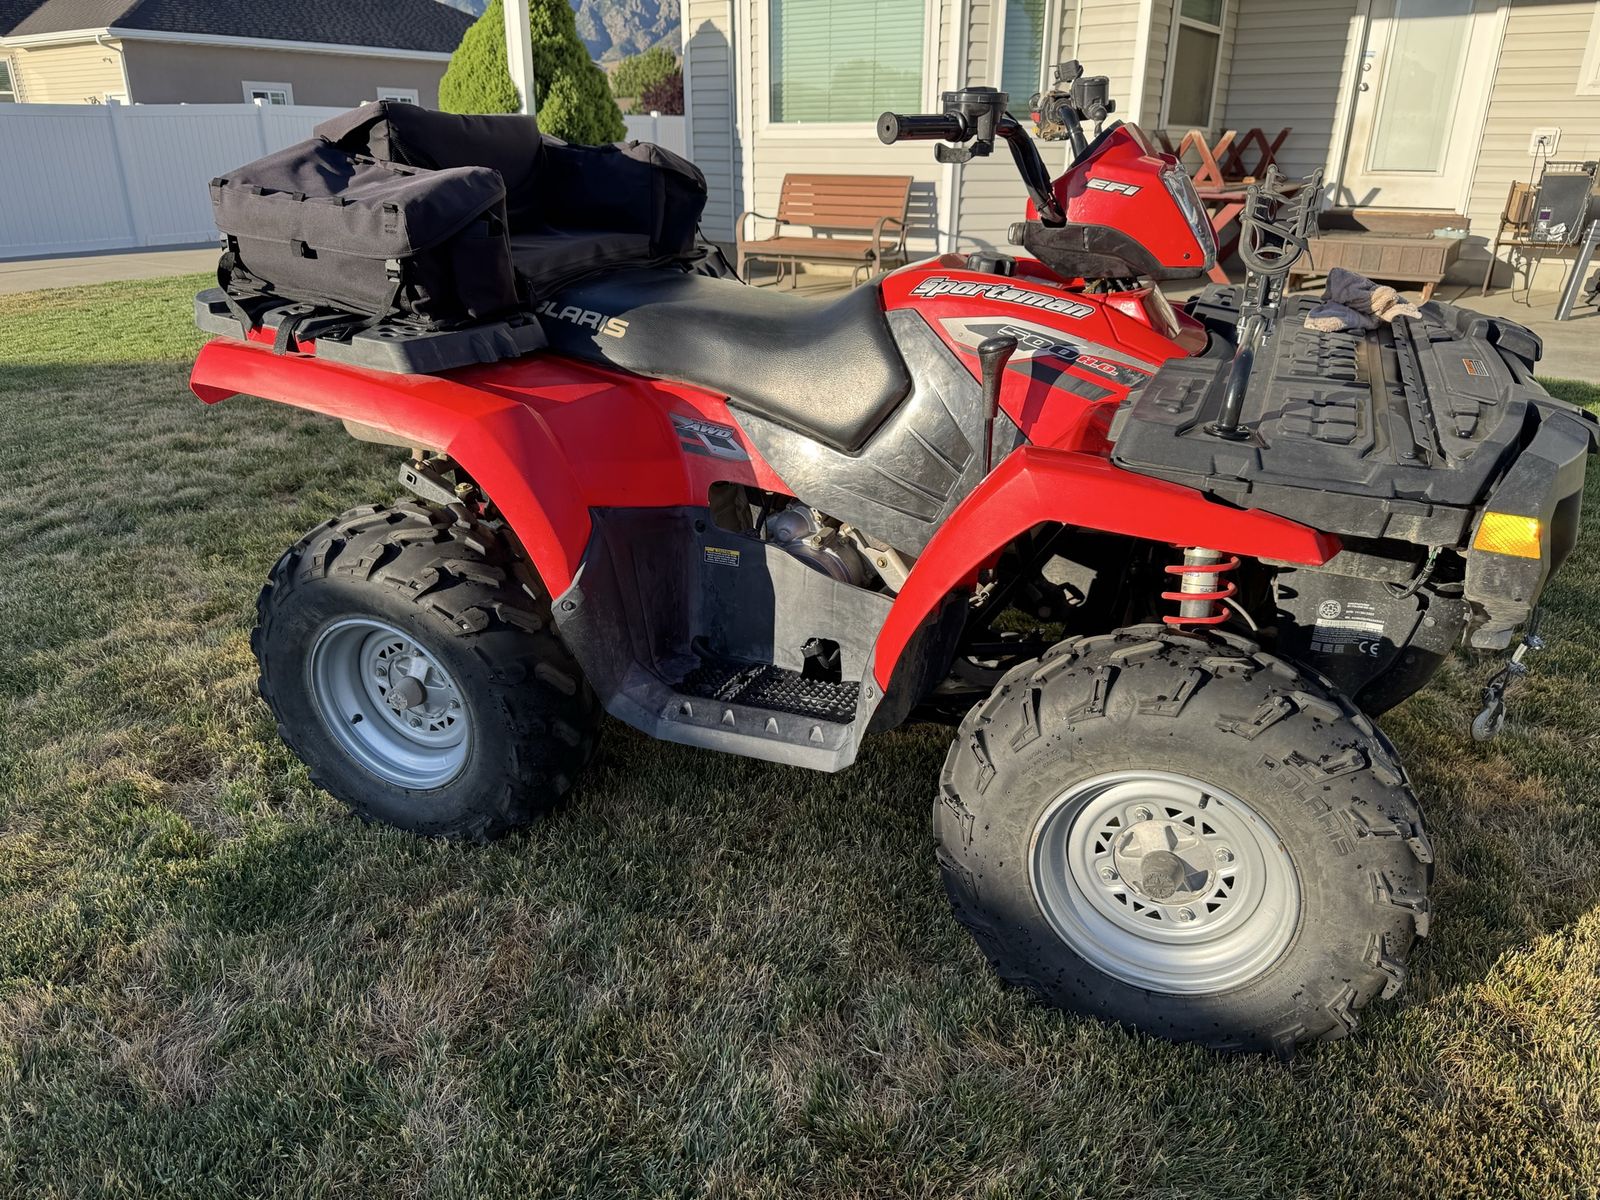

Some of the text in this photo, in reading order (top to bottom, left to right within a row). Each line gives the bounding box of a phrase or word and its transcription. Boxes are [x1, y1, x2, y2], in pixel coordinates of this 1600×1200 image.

[1085, 177, 1142, 197] EFI
[910, 277, 1096, 318] Sportsman
[535, 300, 630, 338] LARIS
[997, 325, 1081, 360] 500
[684, 422, 733, 439] AWD
